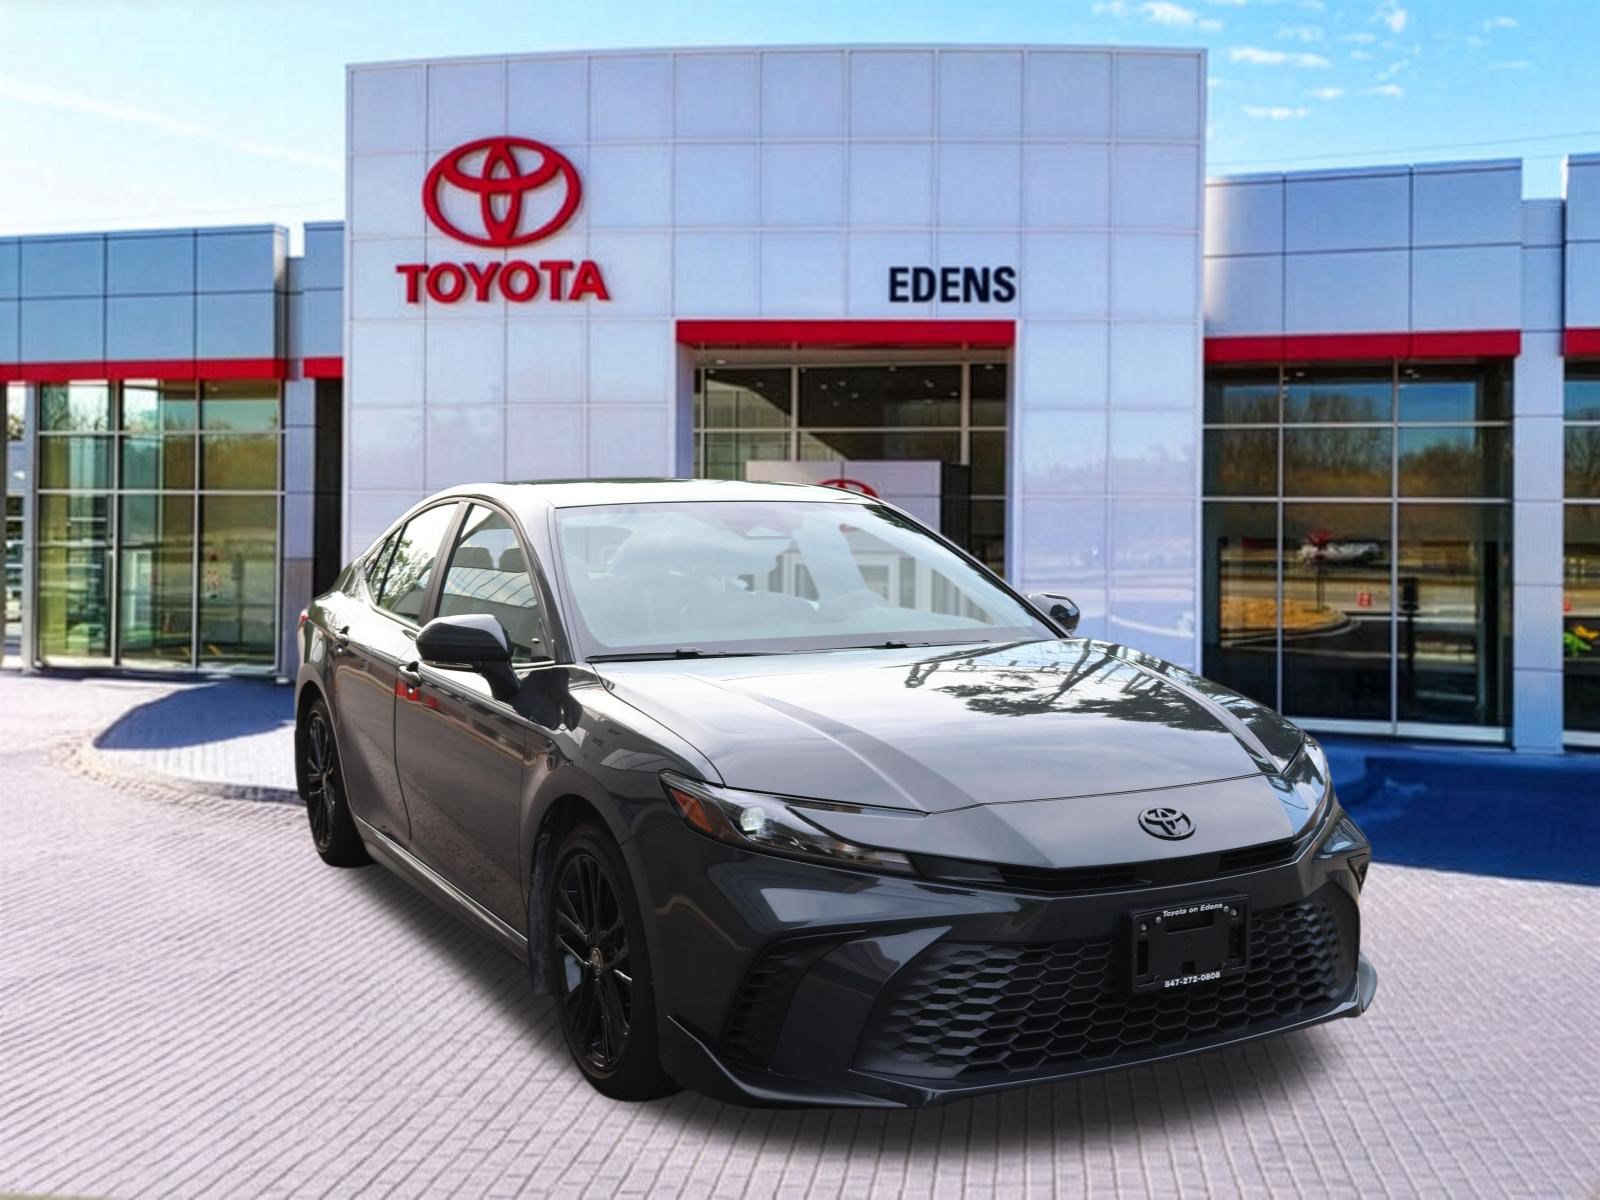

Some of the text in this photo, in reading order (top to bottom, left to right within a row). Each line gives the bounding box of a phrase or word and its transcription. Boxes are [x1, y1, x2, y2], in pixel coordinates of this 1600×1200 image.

[396, 260, 611, 304] TOYOTA
[888, 266, 1016, 303] EDENS
[1162, 902, 1223, 918] Toyota on Edens
[1164, 972, 1221, 988] 847-272-0808
